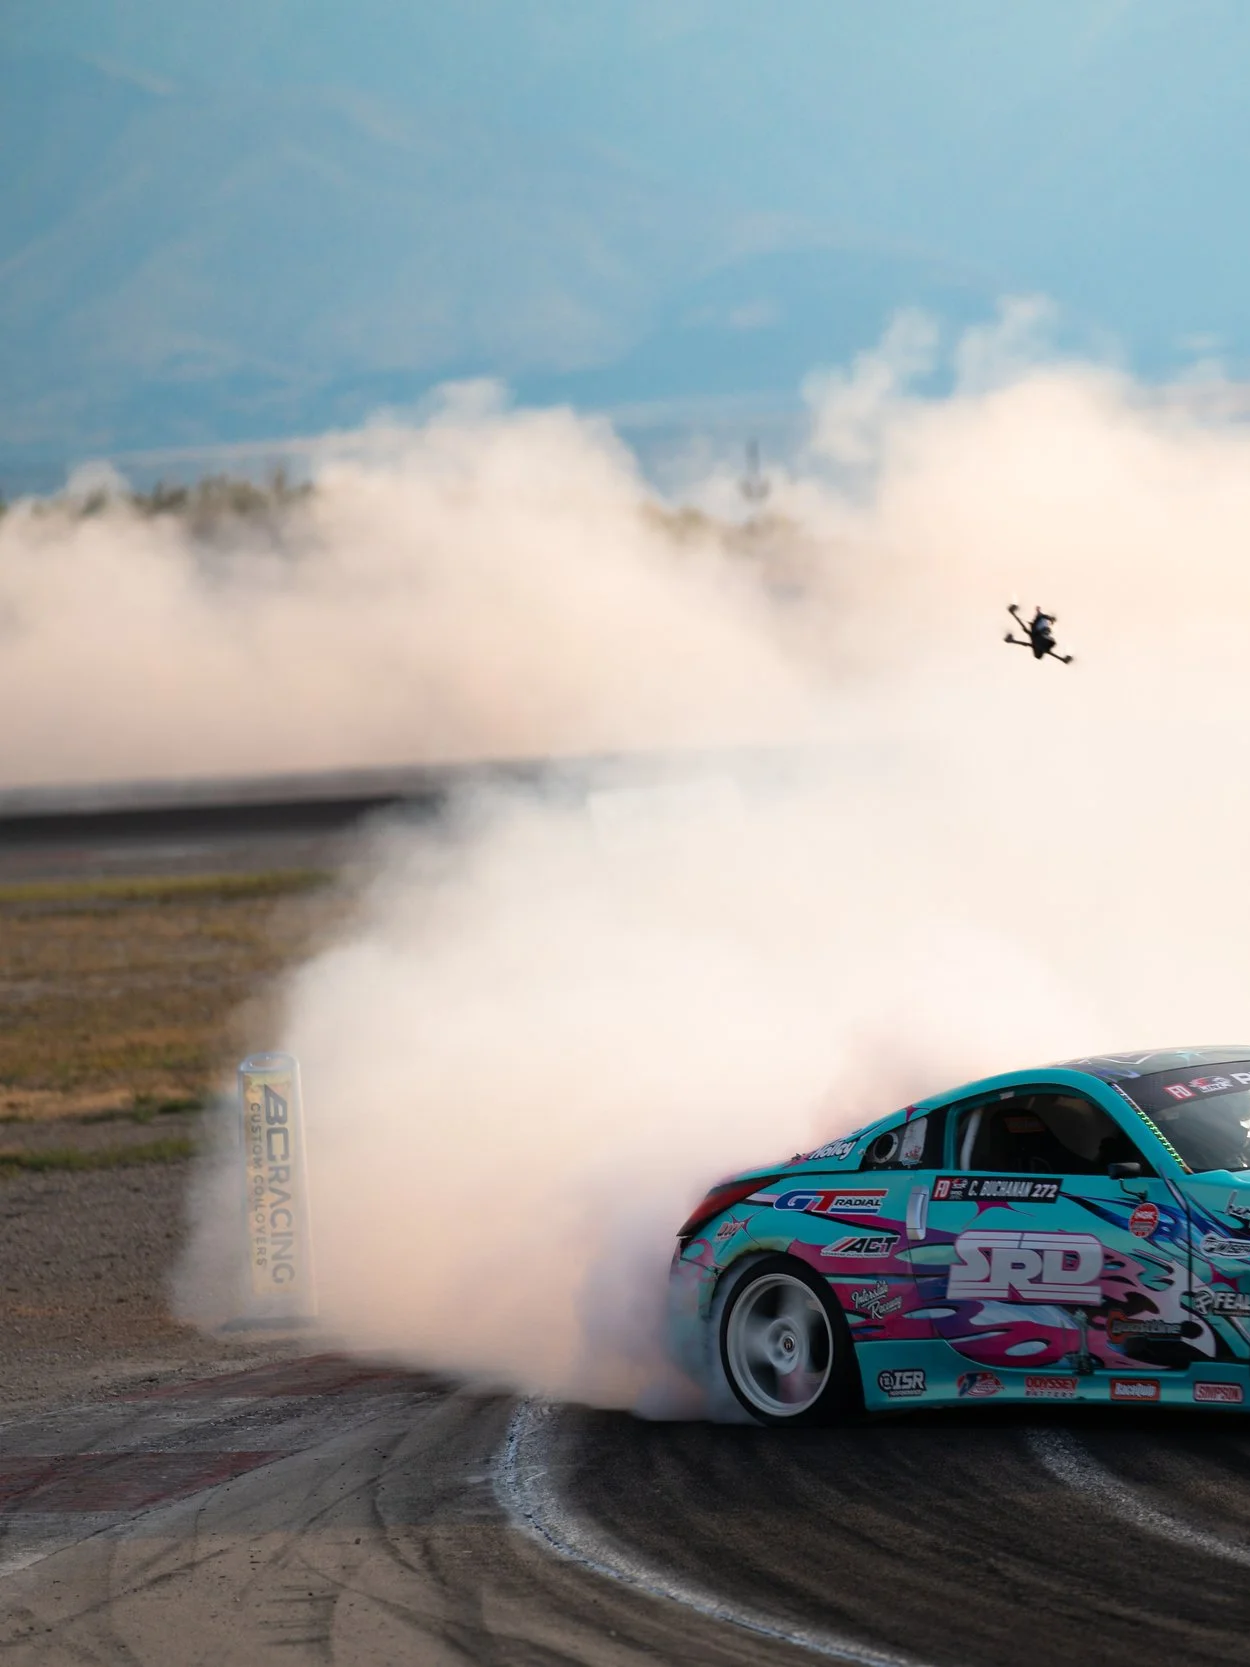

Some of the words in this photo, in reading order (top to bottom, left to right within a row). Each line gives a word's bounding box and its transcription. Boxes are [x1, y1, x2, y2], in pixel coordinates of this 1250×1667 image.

[250, 1102, 262, 1169] CUSTOM
[979, 1181, 1034, 1197] BUCHANAN
[1030, 1184, 1058, 1198] 272
[773, 1189, 888, 1211] GT
[834, 1198, 881, 1206] RADIAL
[253, 1174, 267, 1266] COILOVERS
[838, 1236, 899, 1253] ACT
[947, 1231, 1105, 1306] SRD
[893, 1371, 925, 1390] ISR
[1025, 1376, 1078, 1388] ODYSSEY
